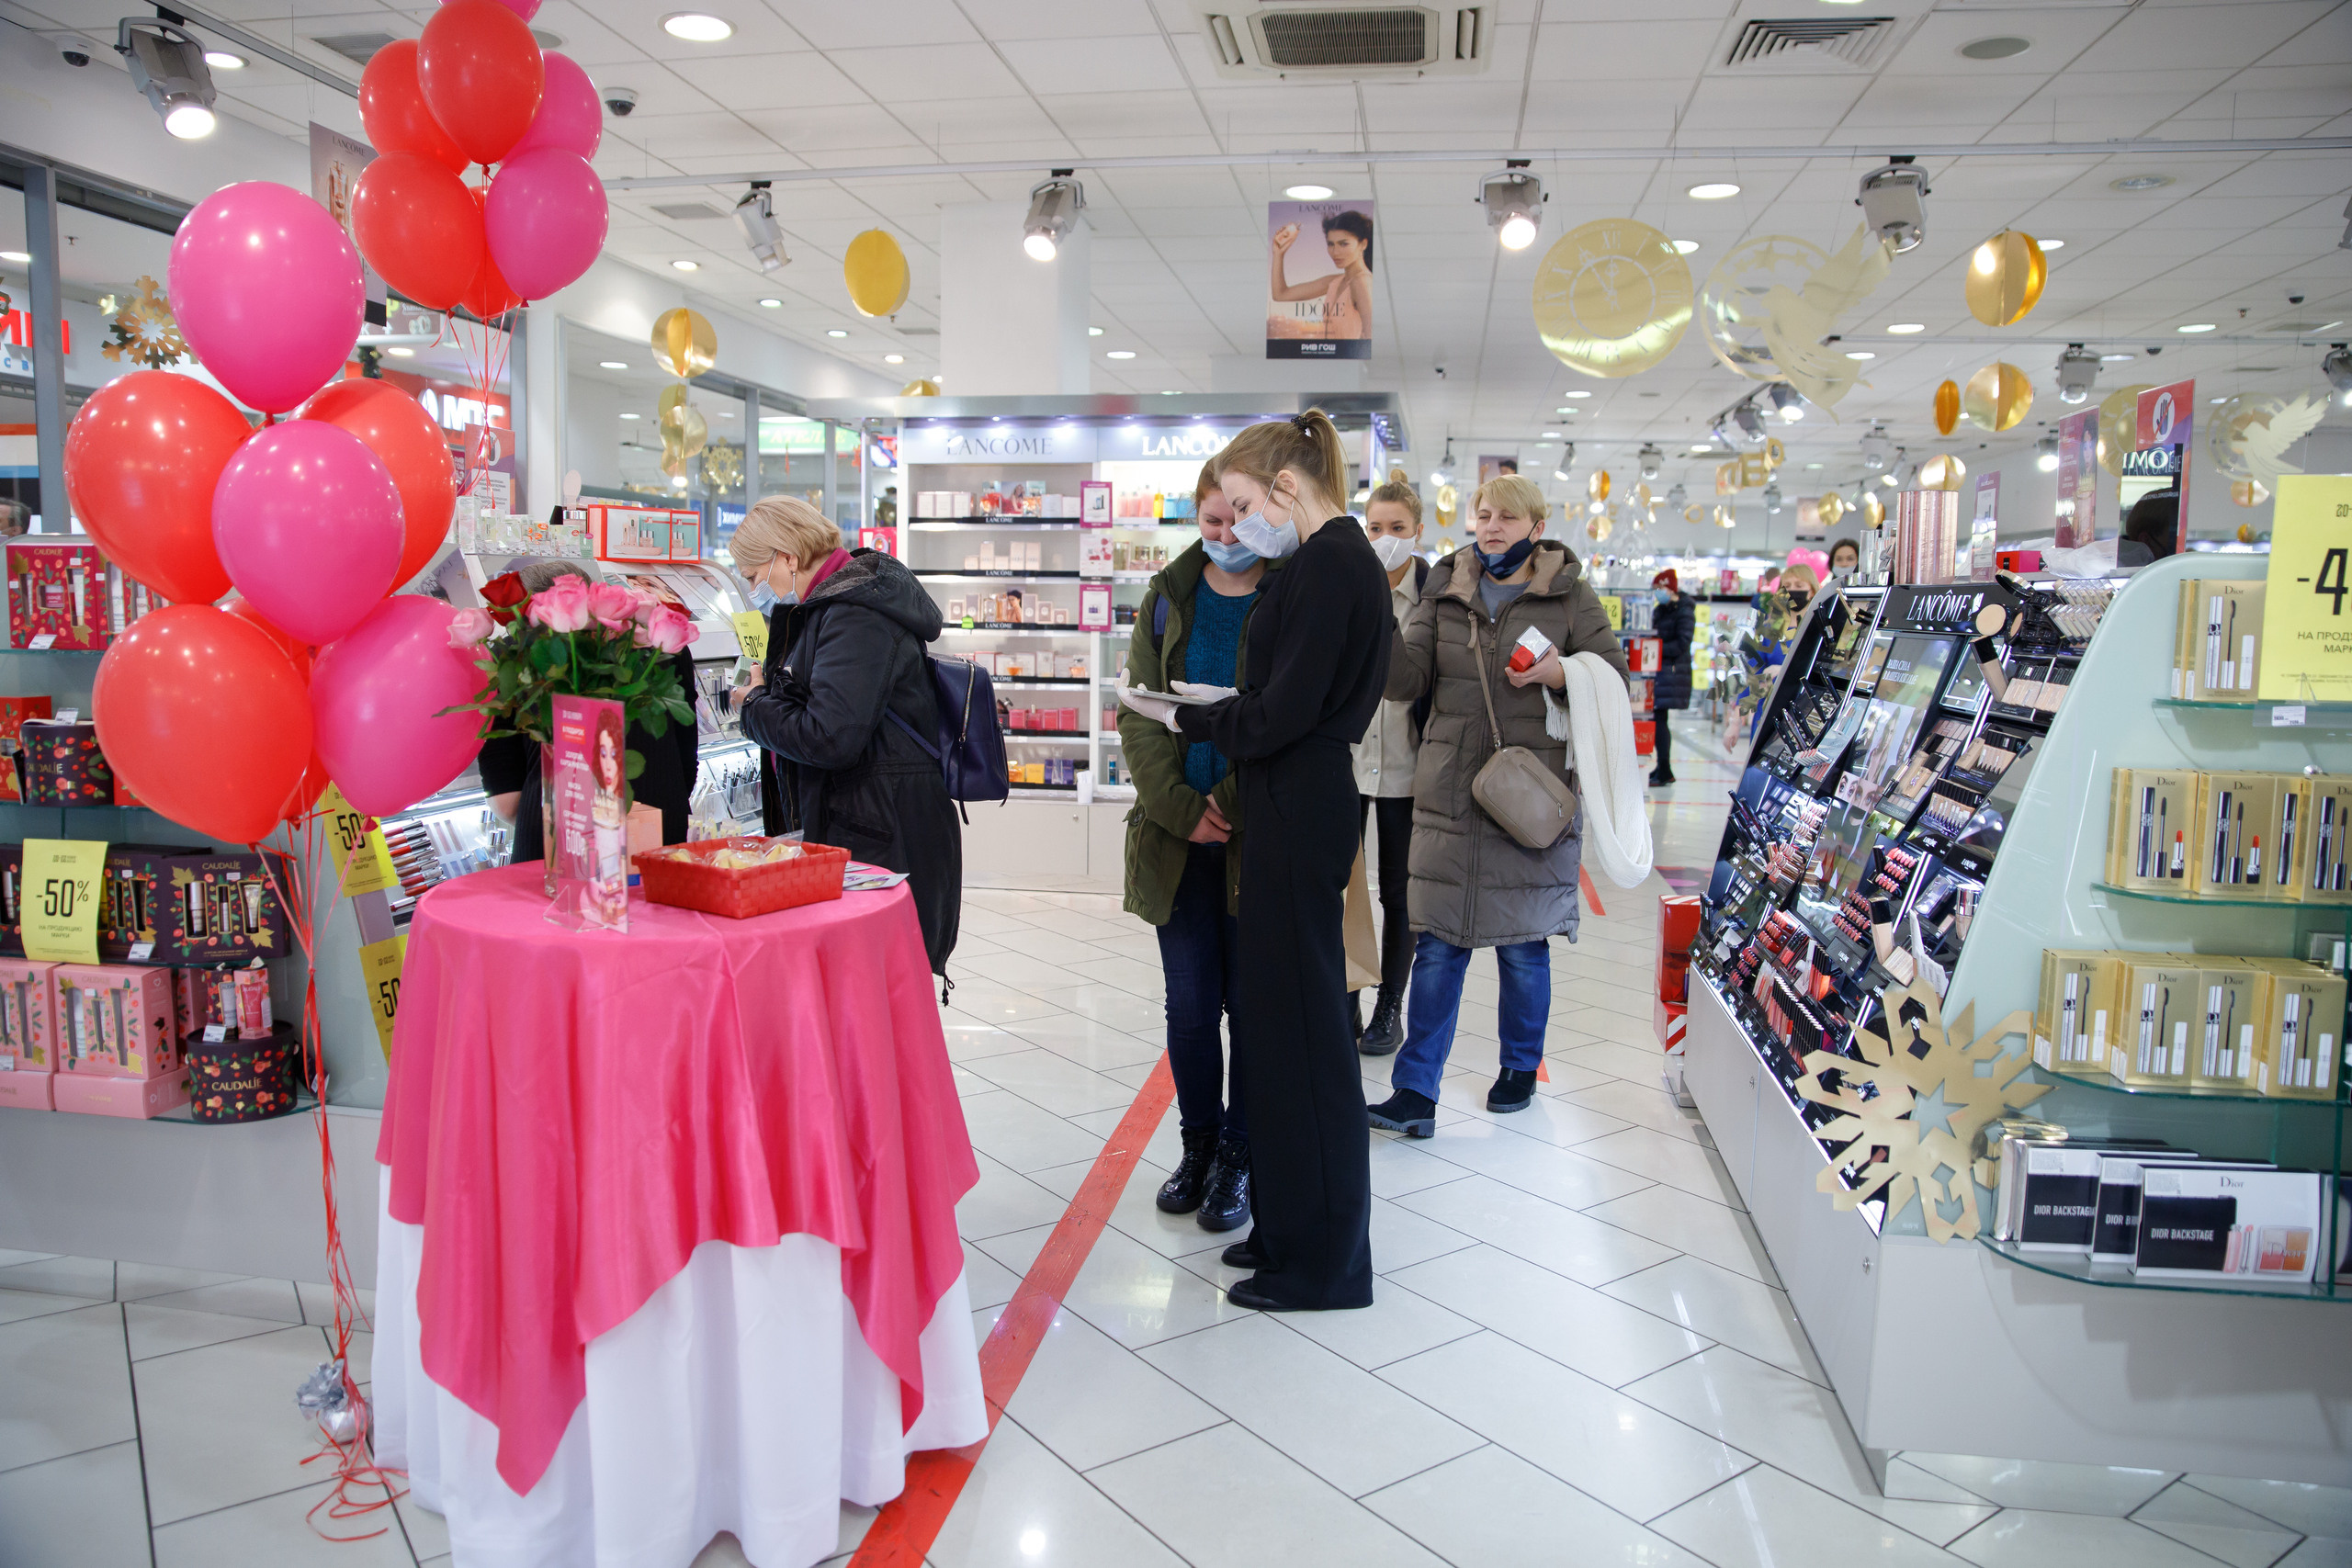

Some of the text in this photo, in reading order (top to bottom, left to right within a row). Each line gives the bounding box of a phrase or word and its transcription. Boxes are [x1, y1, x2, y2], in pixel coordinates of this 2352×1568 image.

[1295, 298, 1345, 317] IDÔLE
[947, 434, 1053, 456] LANCÔME
[2297, 548, 2352, 615] -4
[2224, 585, 2244, 595] Dior
[1906, 589, 1972, 622] LANCÔME
[2298, 631, 2352, 642] НА ПРОД
[2157, 776, 2176, 786] Dior
[2234, 781, 2253, 791] Dior
[334, 813, 366, 852] -50
[36, 878, 90, 917] -50%
[2079, 962, 2098, 972] Dior
[2158, 973, 2177, 983] Dior
[2223, 976, 2244, 985] Dior
[2301, 983, 2323, 994] Dior
[2220, 1176, 2245, 1189] Dior
[2033, 1204, 2093, 1216] DIOR BACKSTAG
[2105, 1213, 2123, 1225] DIOR
[2151, 1227, 2215, 1242] DIOR BACKSTAGE
